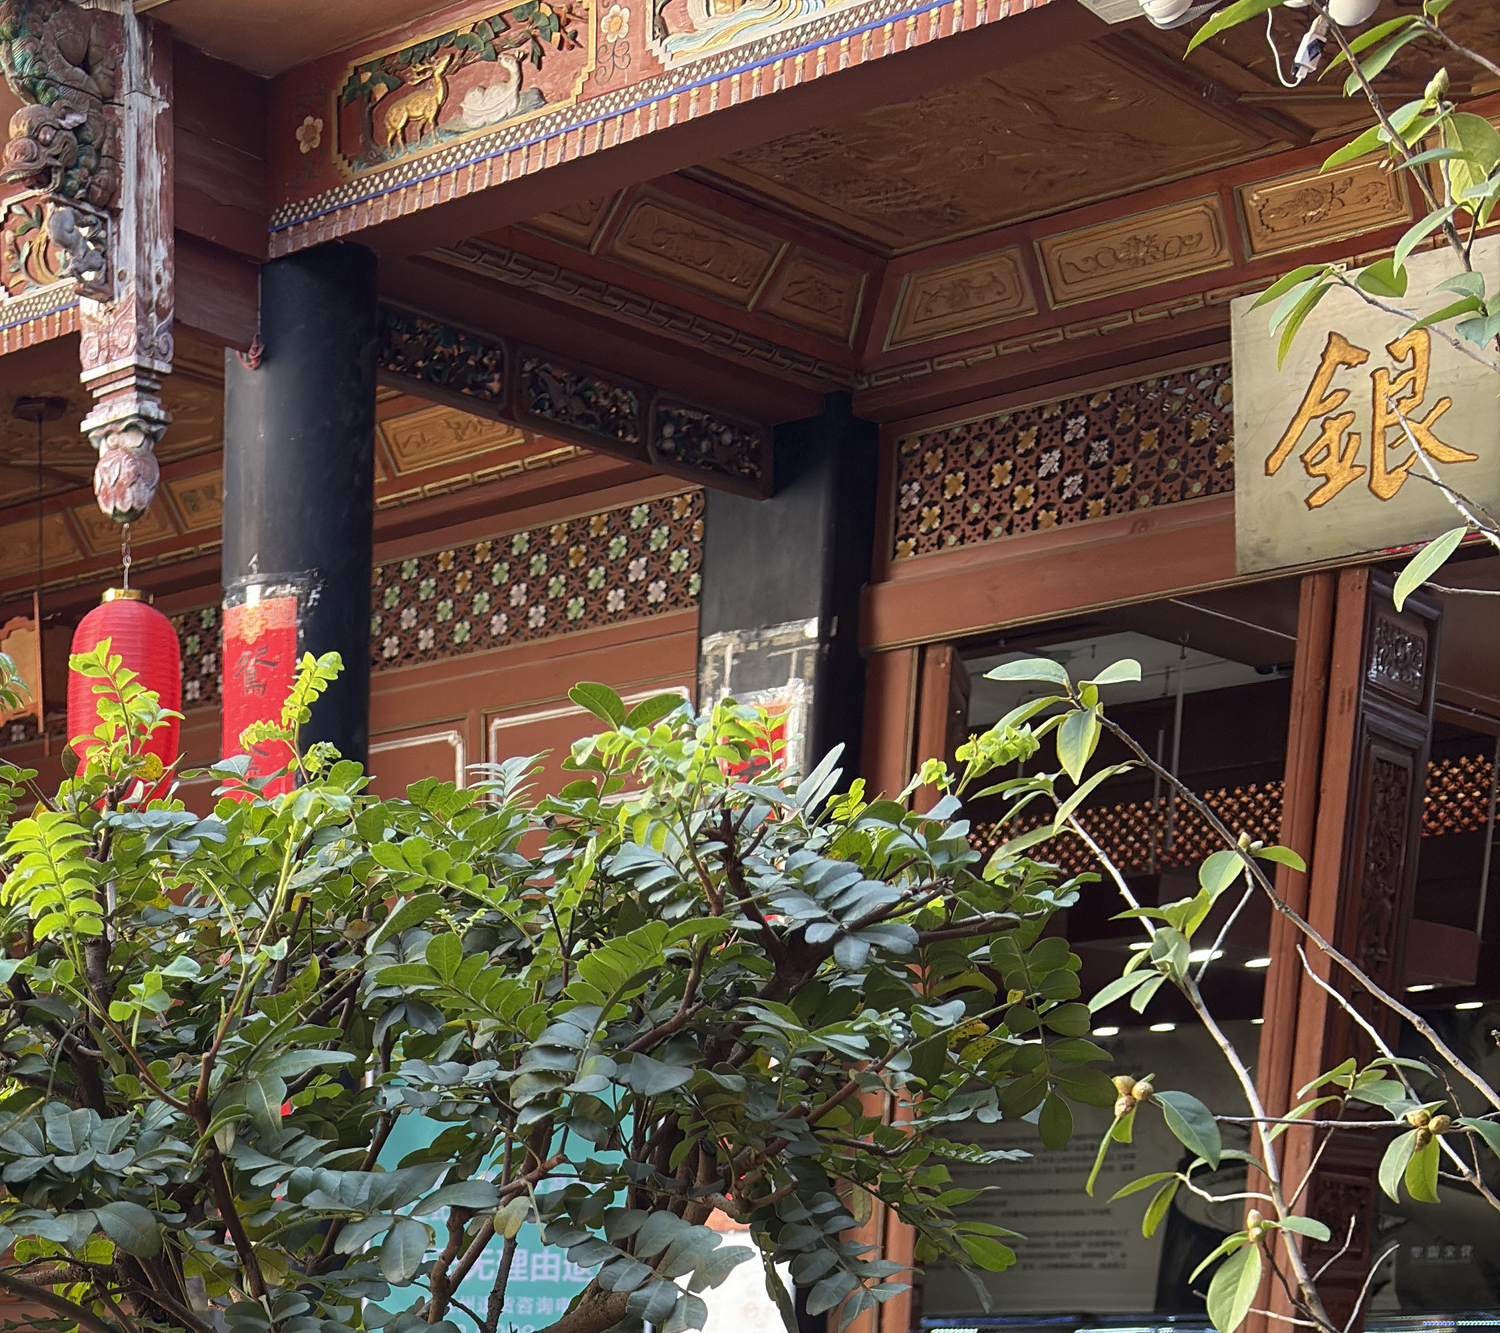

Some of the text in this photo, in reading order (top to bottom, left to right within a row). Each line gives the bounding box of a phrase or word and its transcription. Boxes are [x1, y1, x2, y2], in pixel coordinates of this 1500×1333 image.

[1265, 329, 1480, 510] 銀
[450, 1248, 594, 1283] 无理由退
